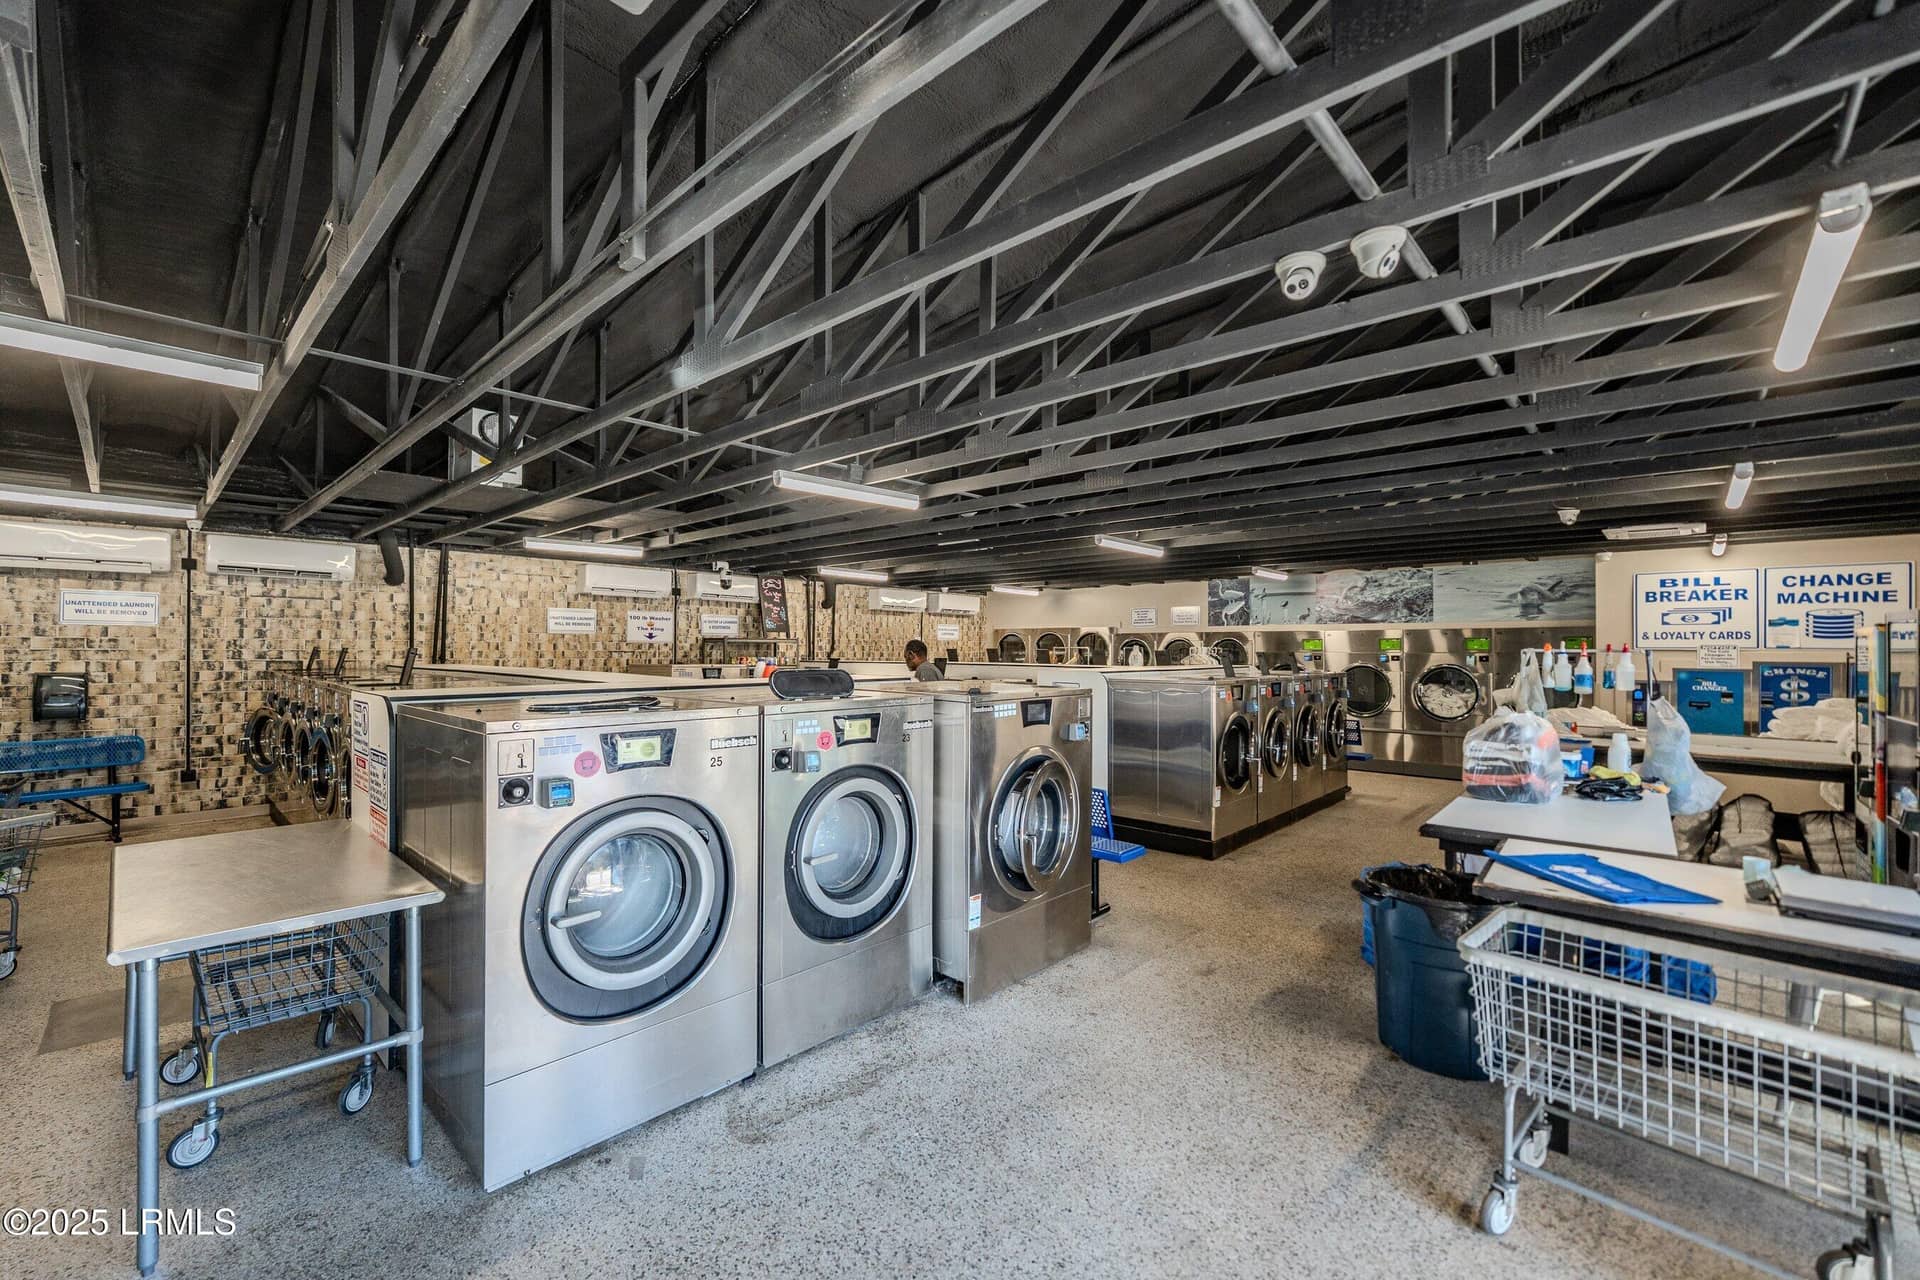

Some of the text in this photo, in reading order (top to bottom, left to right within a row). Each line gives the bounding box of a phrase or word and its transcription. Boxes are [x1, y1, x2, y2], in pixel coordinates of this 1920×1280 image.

[1659, 576, 1731, 588] BILL
[1782, 572, 1892, 587] CHANGE
[1645, 588, 1749, 603] BREAKER
[1777, 590, 1898, 604] MACHINE
[65, 599, 118, 607] UNATTENDED
[1641, 630, 1752, 640] & LOYALTY CARDS
[1763, 667, 1827, 679] CHANGE
[902, 733, 911, 742] 23
[710, 756, 723, 768] 25
